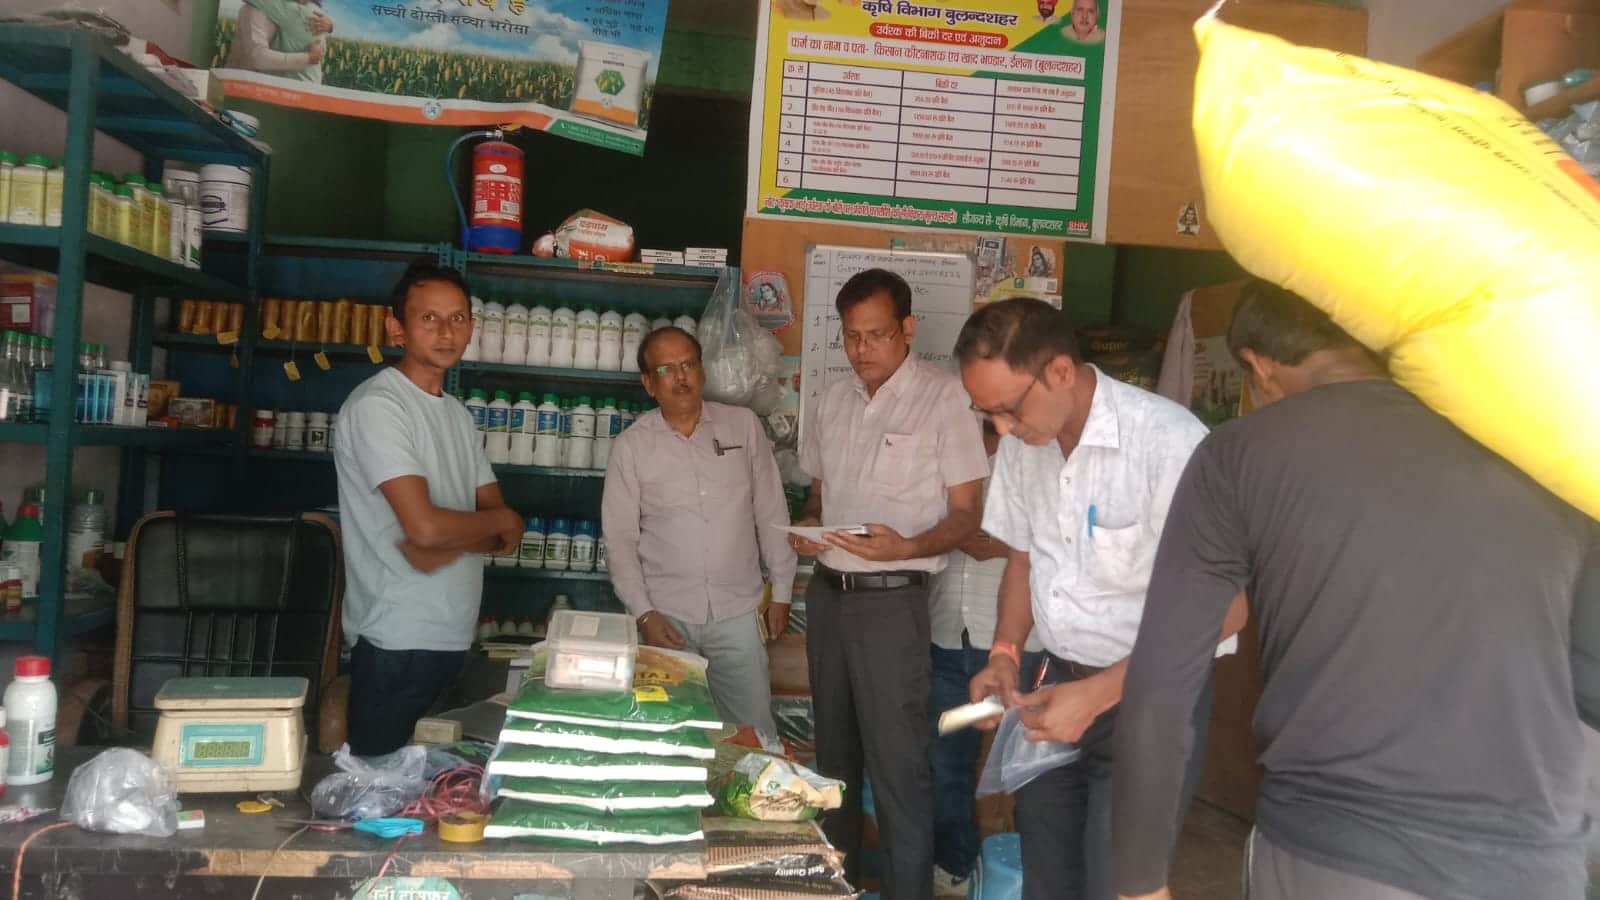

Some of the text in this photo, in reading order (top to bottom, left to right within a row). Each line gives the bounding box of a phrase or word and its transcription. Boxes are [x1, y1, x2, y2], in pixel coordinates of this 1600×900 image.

[371, 4, 406, 18] सच्ची
[411, 7, 447, 24] दोस्ती
[450, 14, 484, 29] सच्चा
[489, 18, 529, 35] भरोसा
[862, 0, 1018, 26] कृषि विभाग बुलन्दशहर
[876, 25, 902, 36] उर्वरक
[905, 28, 917, 38] की
[942, 33, 952, 41] दर
[969, 36, 1001, 47] अनुदान
[792, 35, 807, 49] फर्म
[810, 40, 821, 49] का
[824, 41, 841, 52] नाम
[843, 44, 849, 52] व
[874, 42, 902, 57] किसान
[961, 55, 978, 65] खाद
[1010, 54, 1032, 70] ईलना
[1035, 59, 1082, 74] (बुलन्दशहर)
[786, 121, 792, 129] 3
[783, 176, 789, 184] 6
